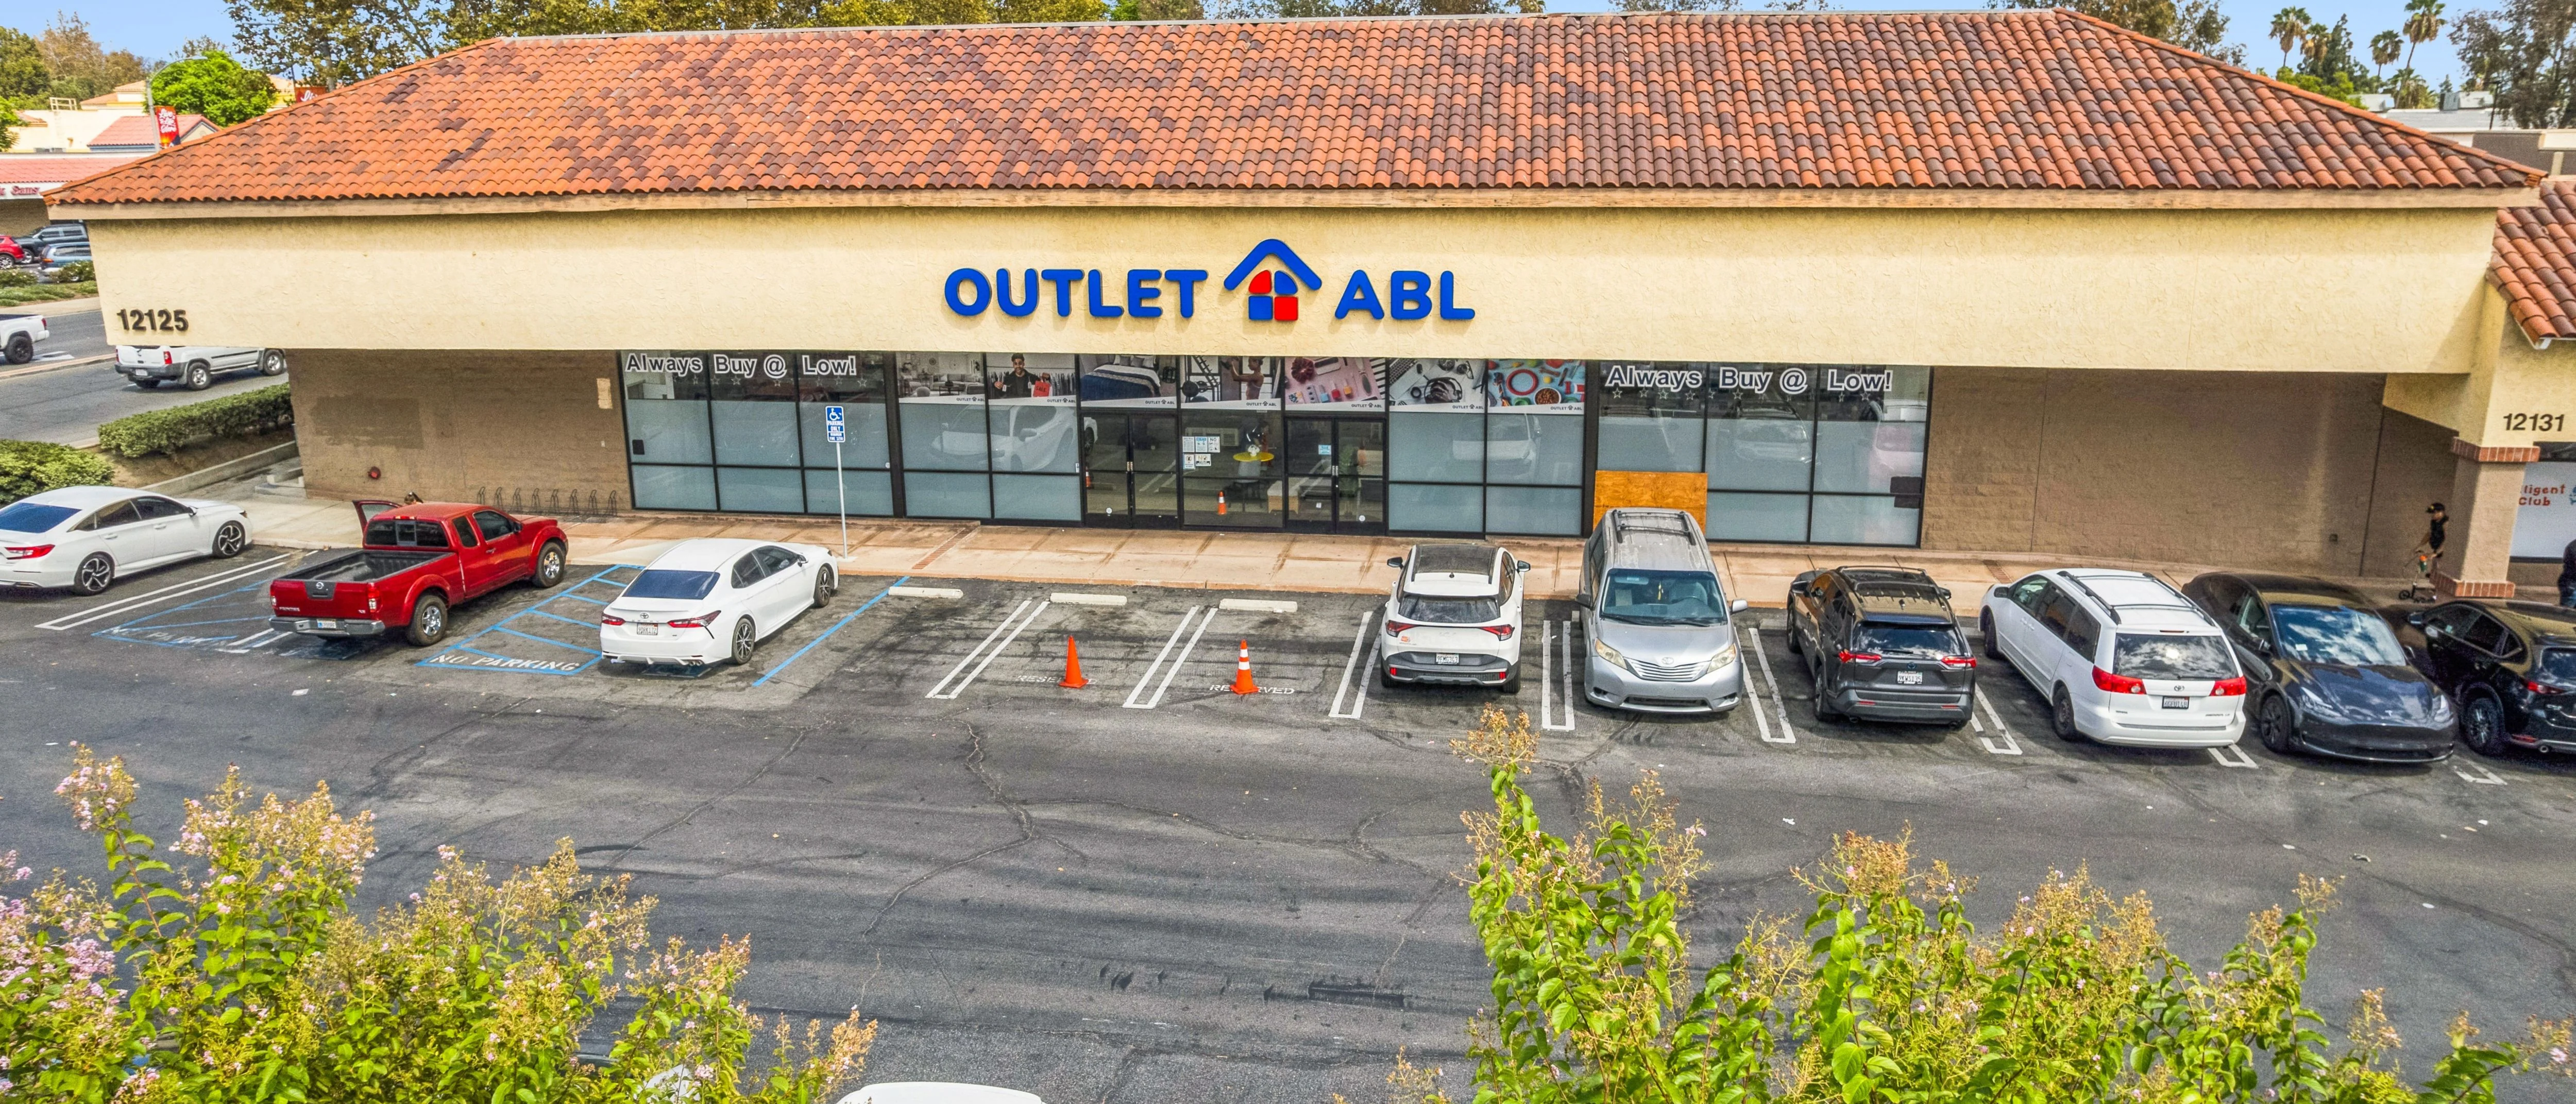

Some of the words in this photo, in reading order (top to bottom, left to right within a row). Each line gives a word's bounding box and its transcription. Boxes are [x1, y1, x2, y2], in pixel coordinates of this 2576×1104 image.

[944, 268, 1208, 317] OUTLET
[1335, 269, 1475, 320] ABL
[116, 309, 189, 331] 12125
[625, 353, 703, 377] Always
[714, 353, 757, 378] Buy
[764, 354, 787, 379] @
[802, 355, 856, 376] Low!
[1605, 365, 1702, 392] Always
[1719, 366, 1773, 394] Buy
[1780, 367, 1808, 395] @
[1827, 369, 1893, 392] Low!
[2503, 413, 2565, 432] 12131
[2521, 484, 2566, 496] ligent
[2519, 497, 2551, 506] Club
[430, 654, 468, 664] NO
[471, 657, 580, 671] PARKING
[1015, 675, 1098, 685] RESED
[1209, 685, 1295, 694] REVED
